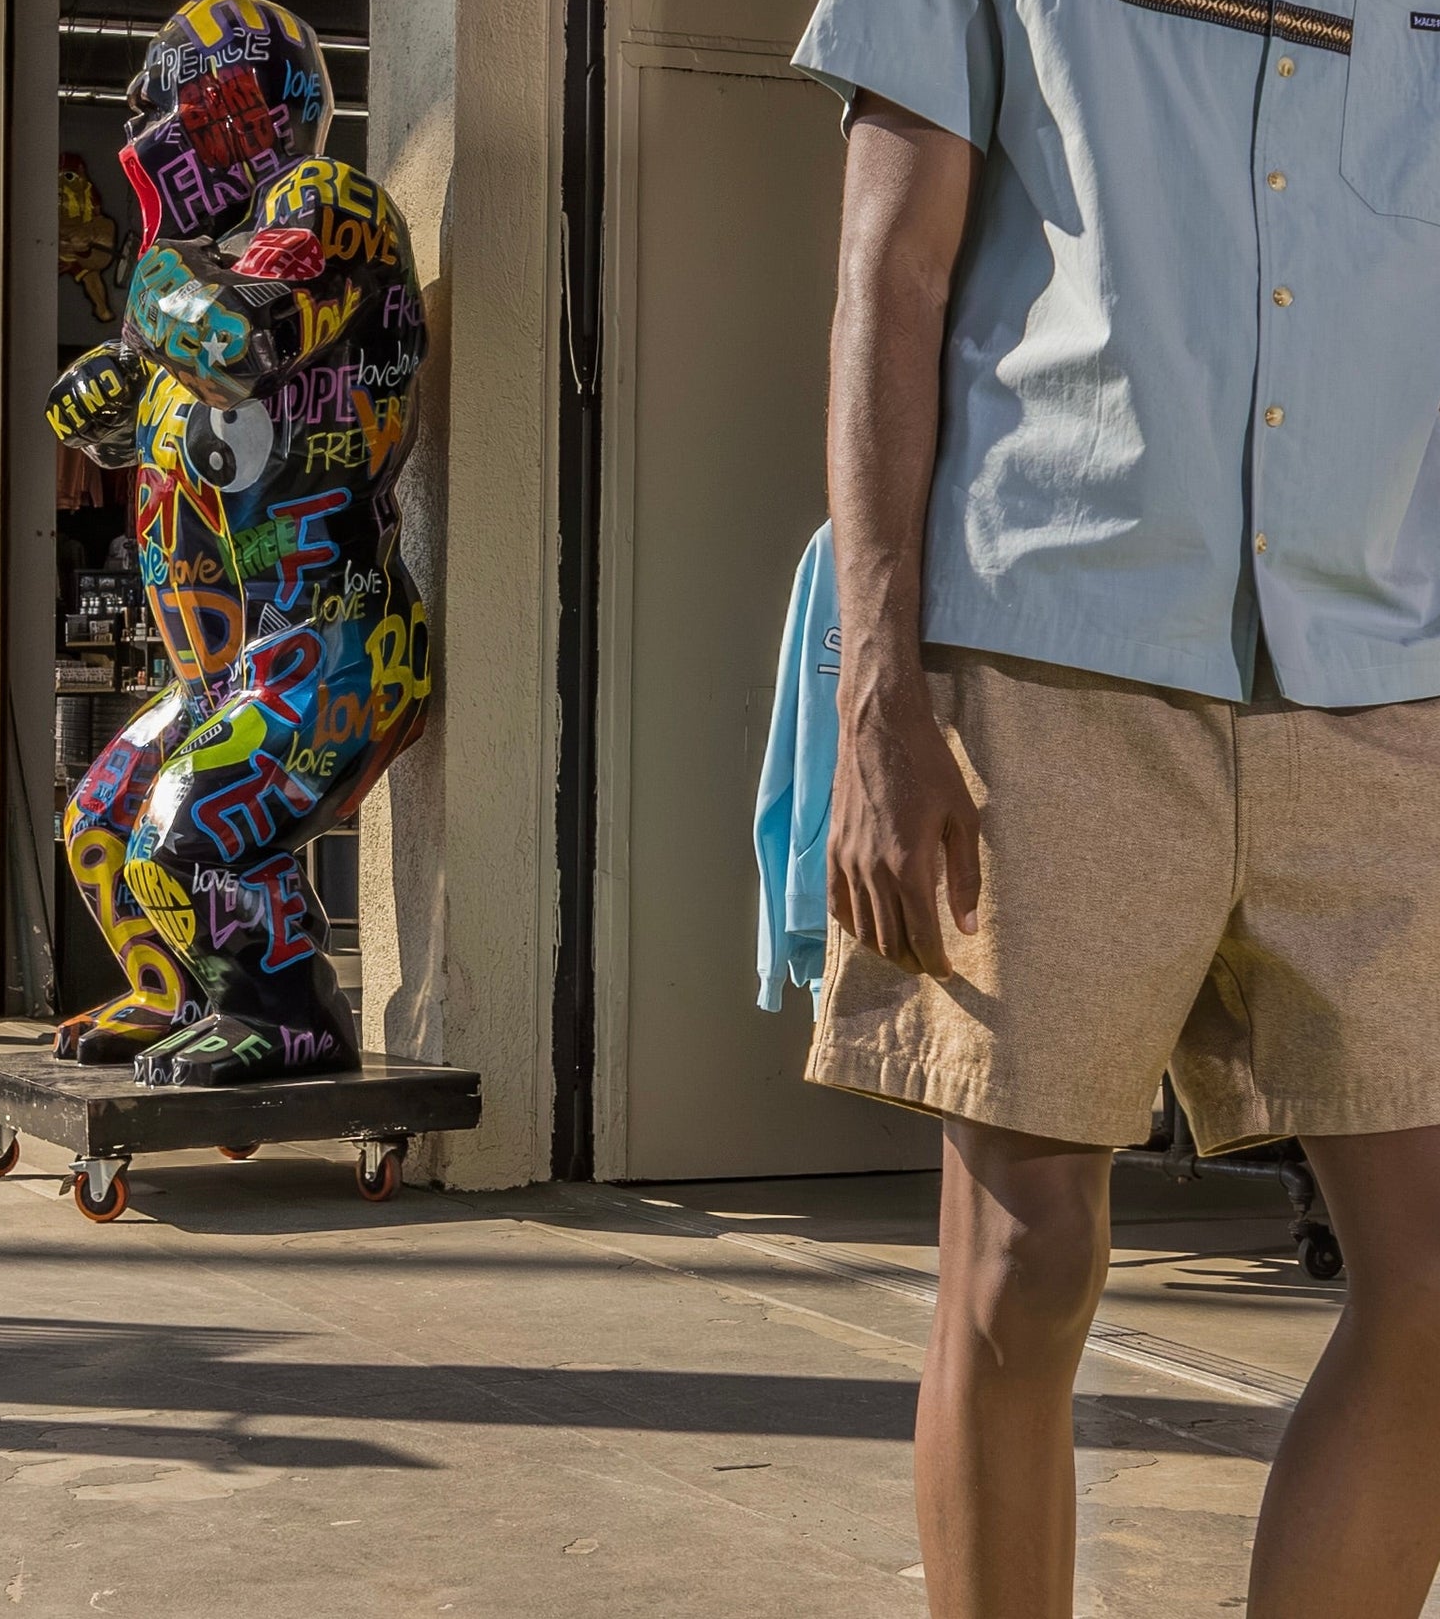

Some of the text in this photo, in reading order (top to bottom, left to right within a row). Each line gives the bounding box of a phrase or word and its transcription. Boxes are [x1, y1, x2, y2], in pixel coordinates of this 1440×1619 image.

[321, 204, 402, 266] LOVE
[285, 731, 337, 777] LOVE
[192, 863, 239, 895] LOVE
